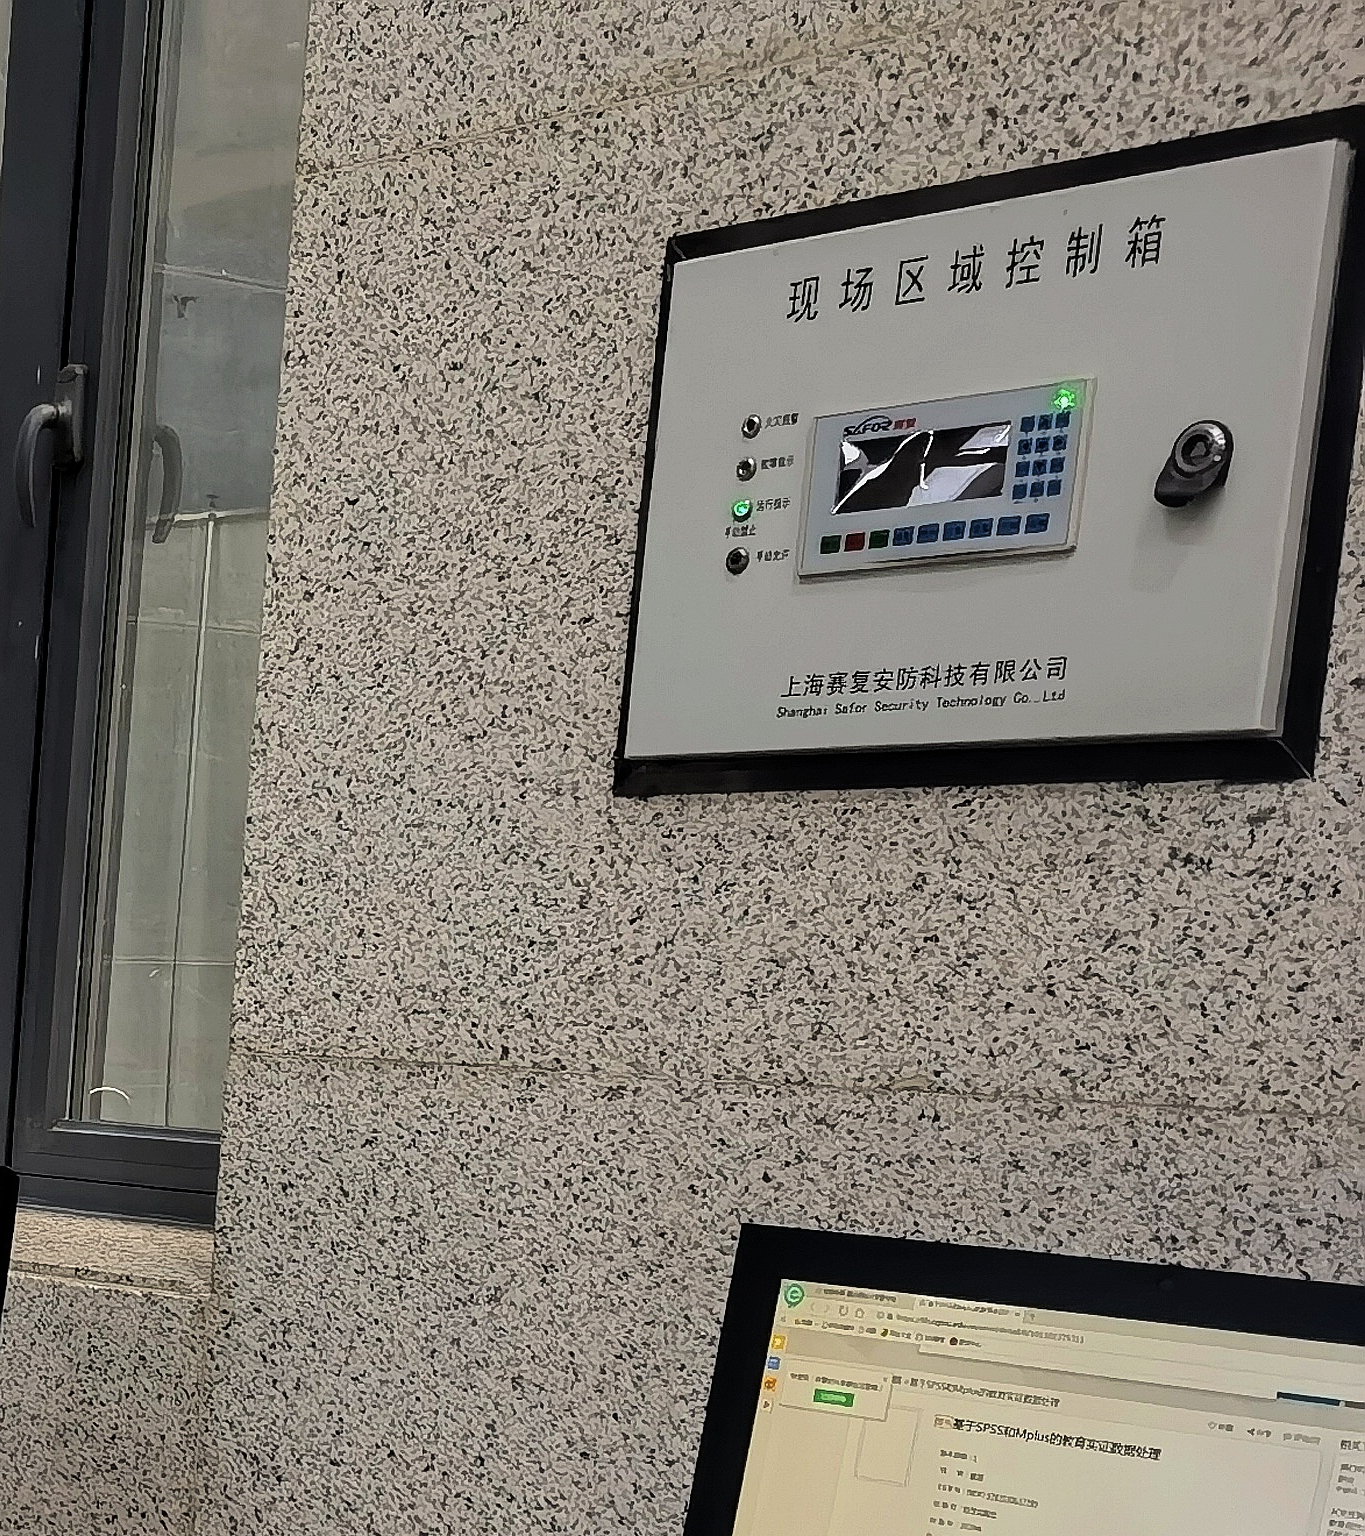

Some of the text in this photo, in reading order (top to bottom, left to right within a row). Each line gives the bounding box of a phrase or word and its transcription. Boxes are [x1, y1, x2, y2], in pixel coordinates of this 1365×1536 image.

[785, 213, 1167, 324] 现场区域控制箱
[780, 655, 1068, 698] 上海赛复安防科技有限公司
[776, 705, 828, 719] Shanghai
[834, 701, 868, 715] Safor
[873, 698, 929, 713] Security
[936, 694, 1007, 710] Technology
